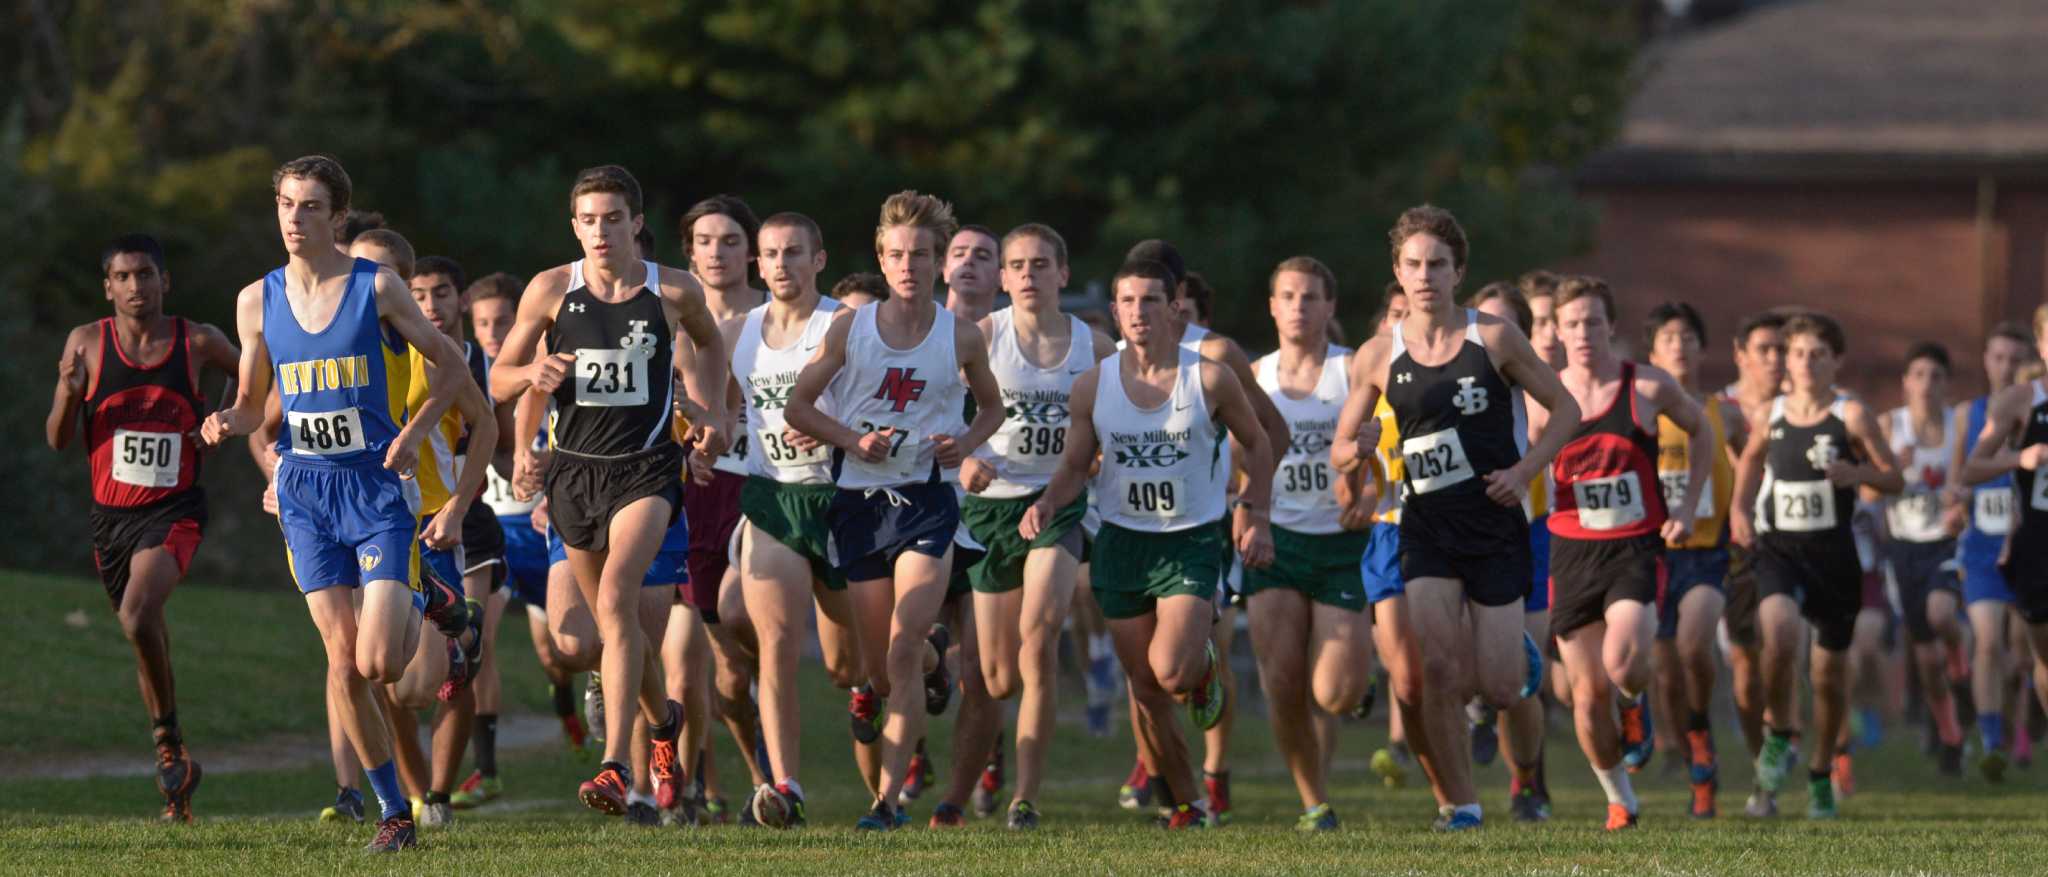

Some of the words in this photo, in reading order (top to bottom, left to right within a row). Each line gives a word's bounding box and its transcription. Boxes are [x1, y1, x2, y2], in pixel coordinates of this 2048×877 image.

[279, 355, 370, 395] NEWTOWN
[585, 362, 638, 394] 231
[747, 374, 773, 388] New
[873, 367, 928, 413] NF
[1002, 389, 1029, 403] New
[1032, 389, 1071, 404] Milfor
[299, 414, 353, 450] 486
[765, 432, 815, 461] 39
[1018, 426, 1067, 456] 398
[1110, 431, 1140, 445] New
[1143, 427, 1192, 444] Milford
[122, 435, 172, 468] 550
[1411, 443, 1460, 480] 252
[1283, 462, 1329, 493] 396
[1127, 481, 1176, 513] 409
[1583, 479, 1633, 511] 579
[1782, 493, 1825, 519] 239
